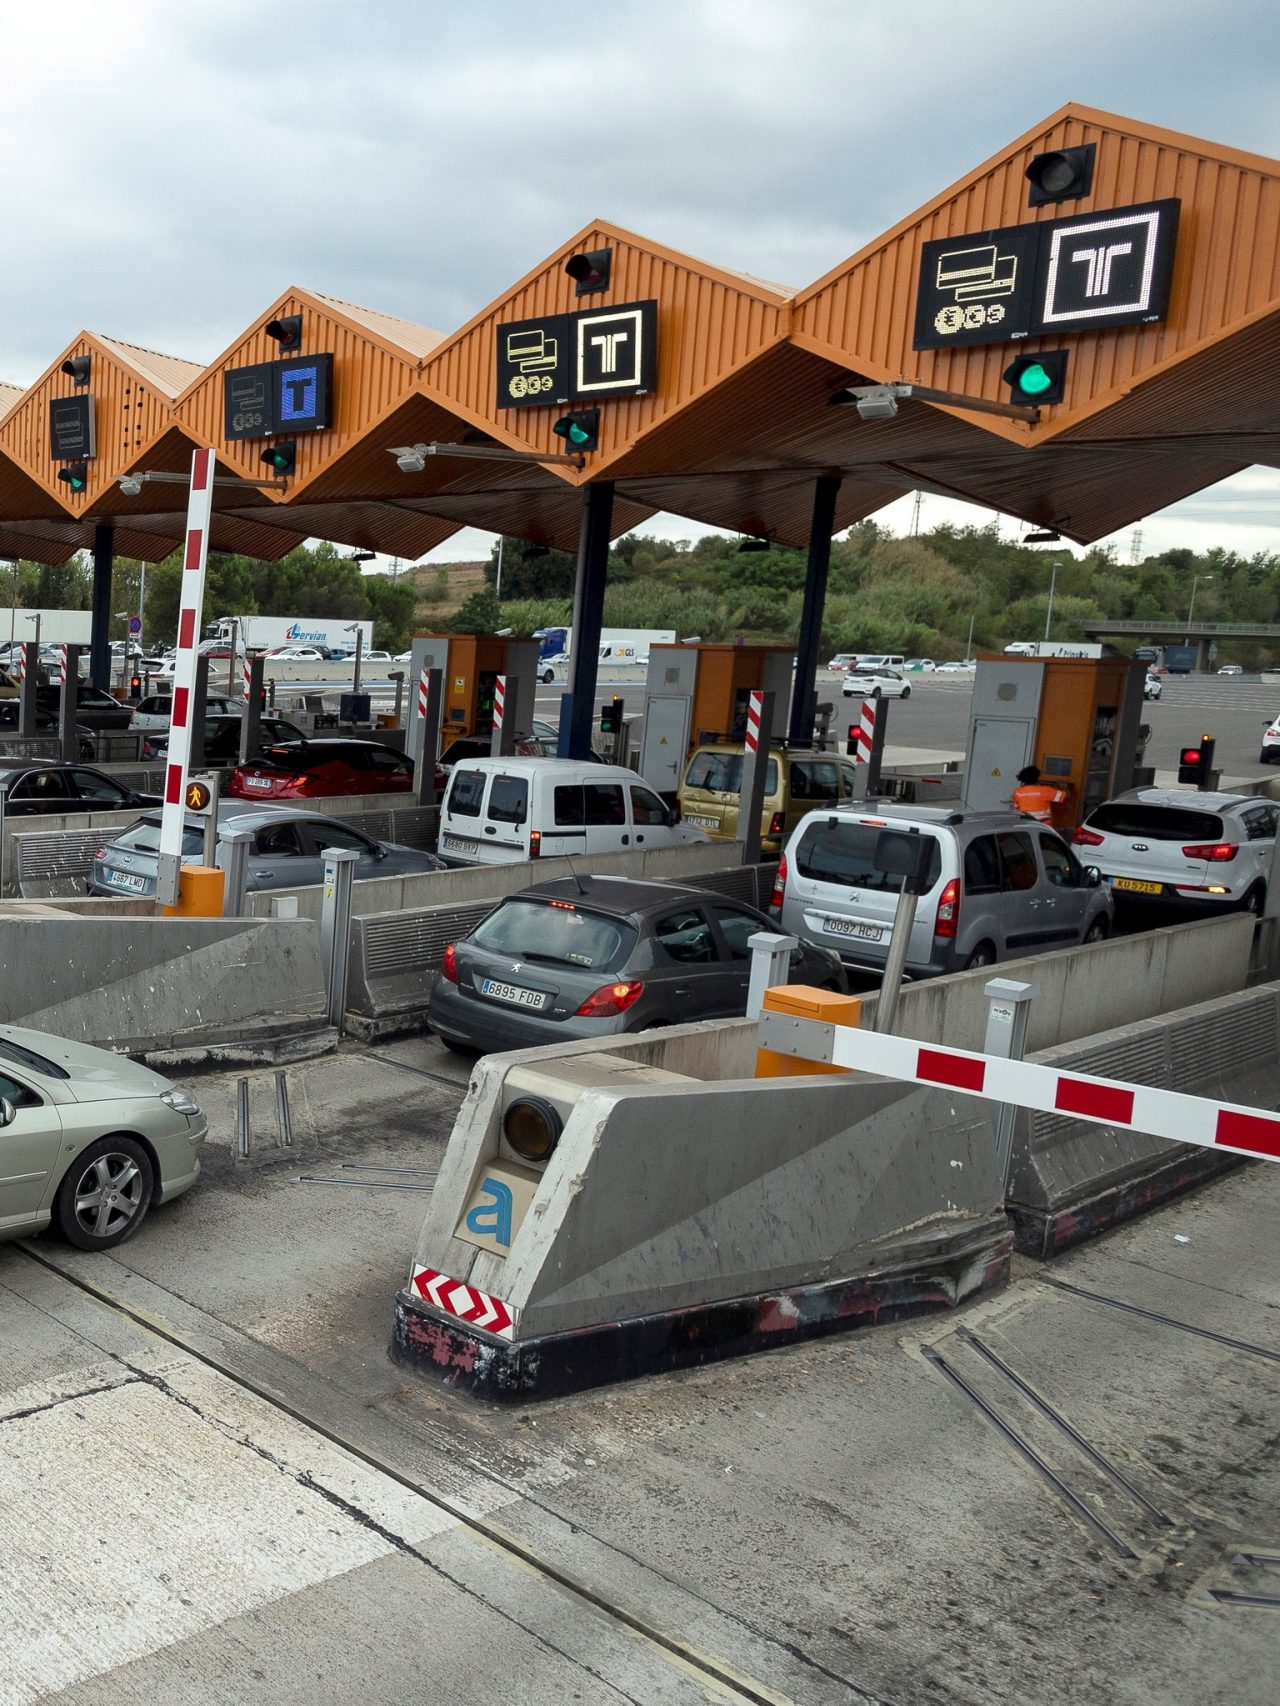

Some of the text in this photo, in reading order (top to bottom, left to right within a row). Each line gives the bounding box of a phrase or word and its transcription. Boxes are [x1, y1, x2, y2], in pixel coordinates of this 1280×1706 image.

[1072, 242, 1132, 297] T
[591, 332, 628, 373] T
[286, 378, 313, 412] T
[830, 921, 856, 933] 0097
[488, 982, 541, 1006] 6895 FDB
[466, 1176, 513, 1248] a
